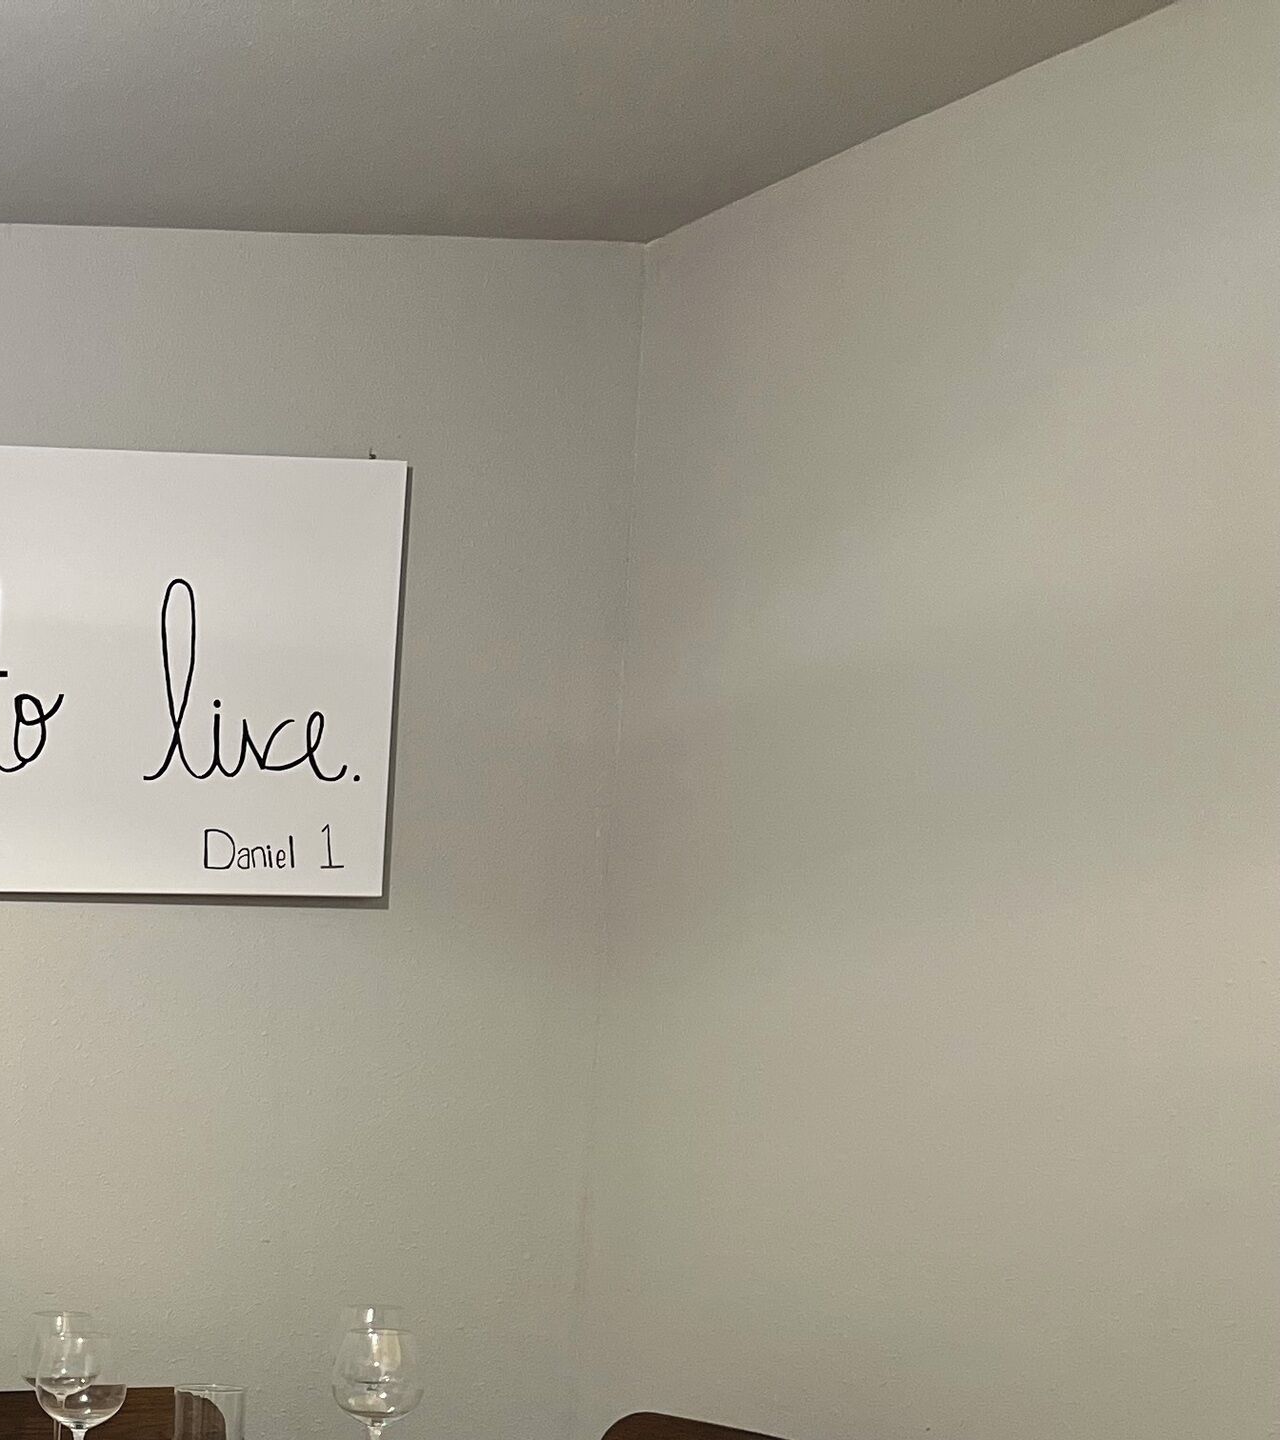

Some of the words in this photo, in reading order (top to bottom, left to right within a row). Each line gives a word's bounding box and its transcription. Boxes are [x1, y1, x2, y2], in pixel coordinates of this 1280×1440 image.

[143, 578, 362, 782] live.
[203, 828, 296, 870] Daniel
[320, 823, 345, 870] 1
